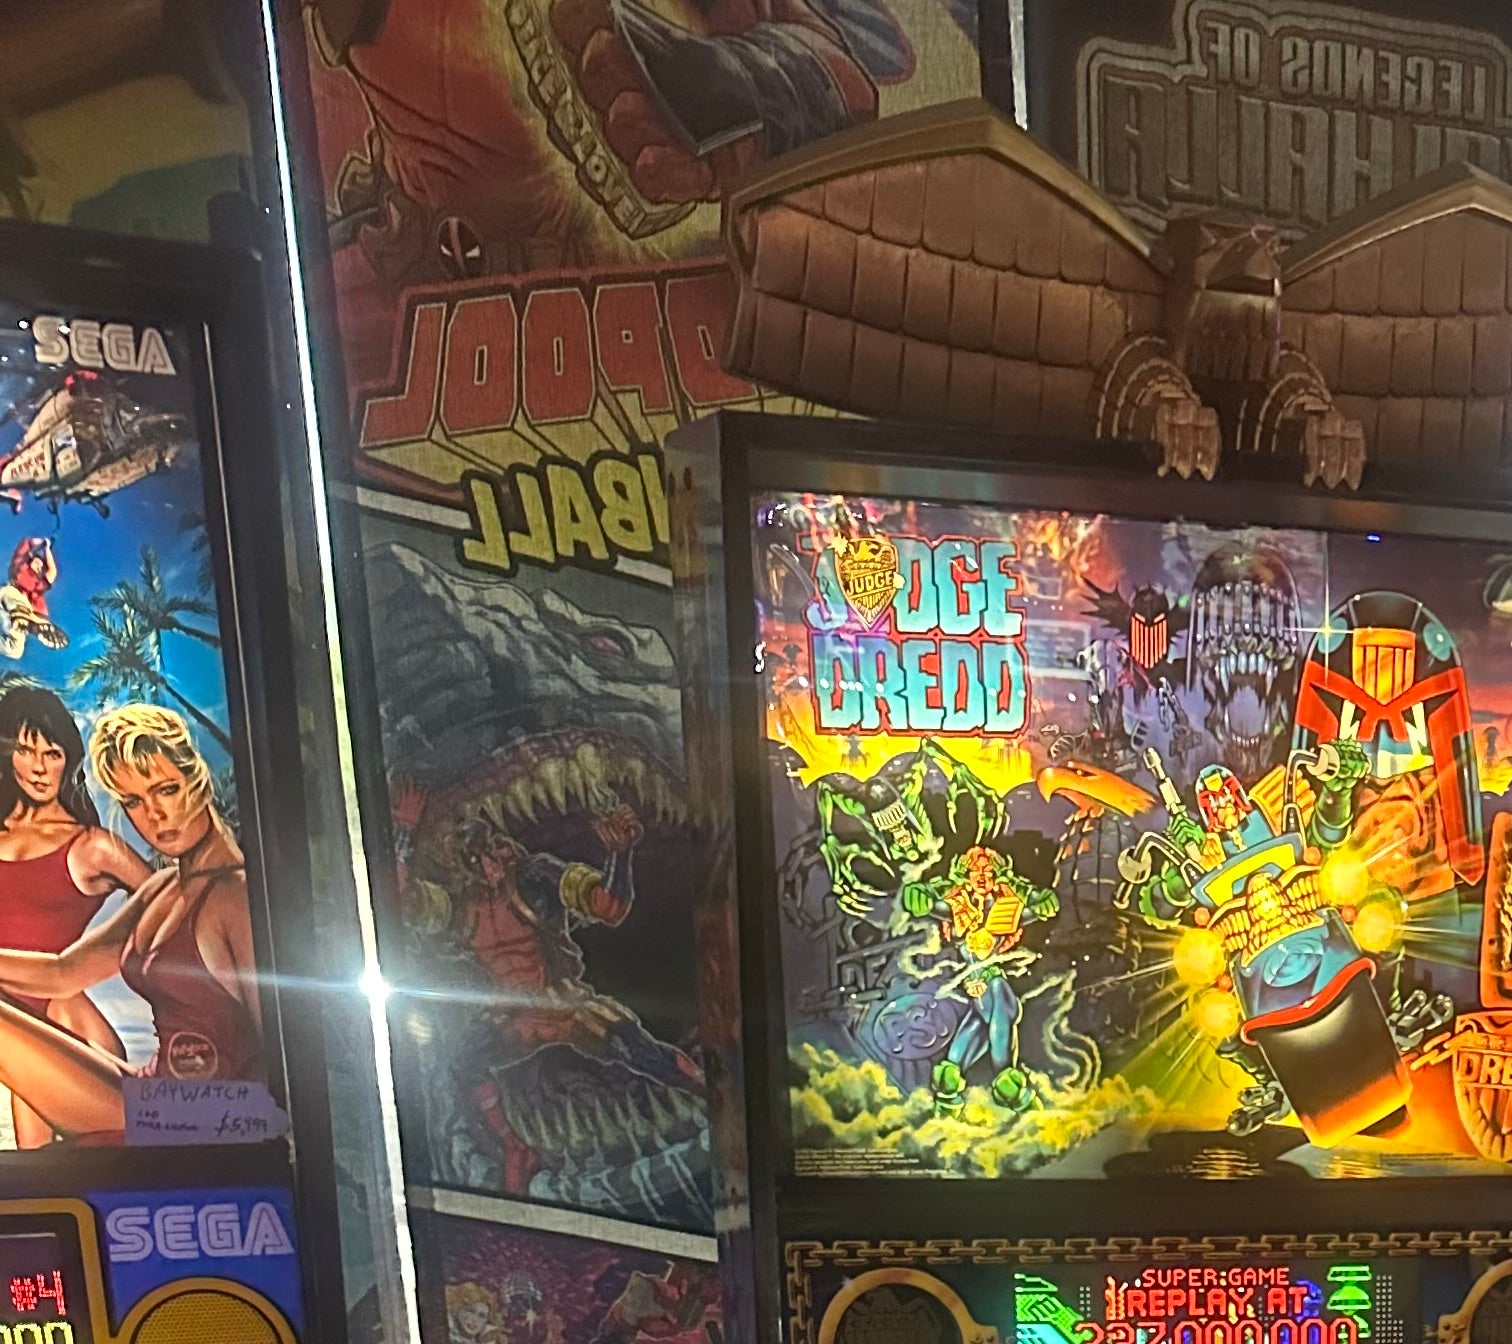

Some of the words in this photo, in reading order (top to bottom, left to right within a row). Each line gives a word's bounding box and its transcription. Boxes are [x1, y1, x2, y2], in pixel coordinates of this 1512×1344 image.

[32, 314, 177, 376] SEGA
[799, 535, 1022, 636] JDGE
[845, 569, 894, 596] JUDGE
[811, 637, 1029, 734] DREDD
[140, 1080, 250, 1103] BAYWATCH
[106, 1201, 294, 1261] SEGA
[1142, 1267, 1220, 1287] SUPER
[1231, 1266, 1290, 1286] GAME
[1126, 1287, 1252, 1318] REPLAY
[1266, 1286, 1309, 1315] AT
